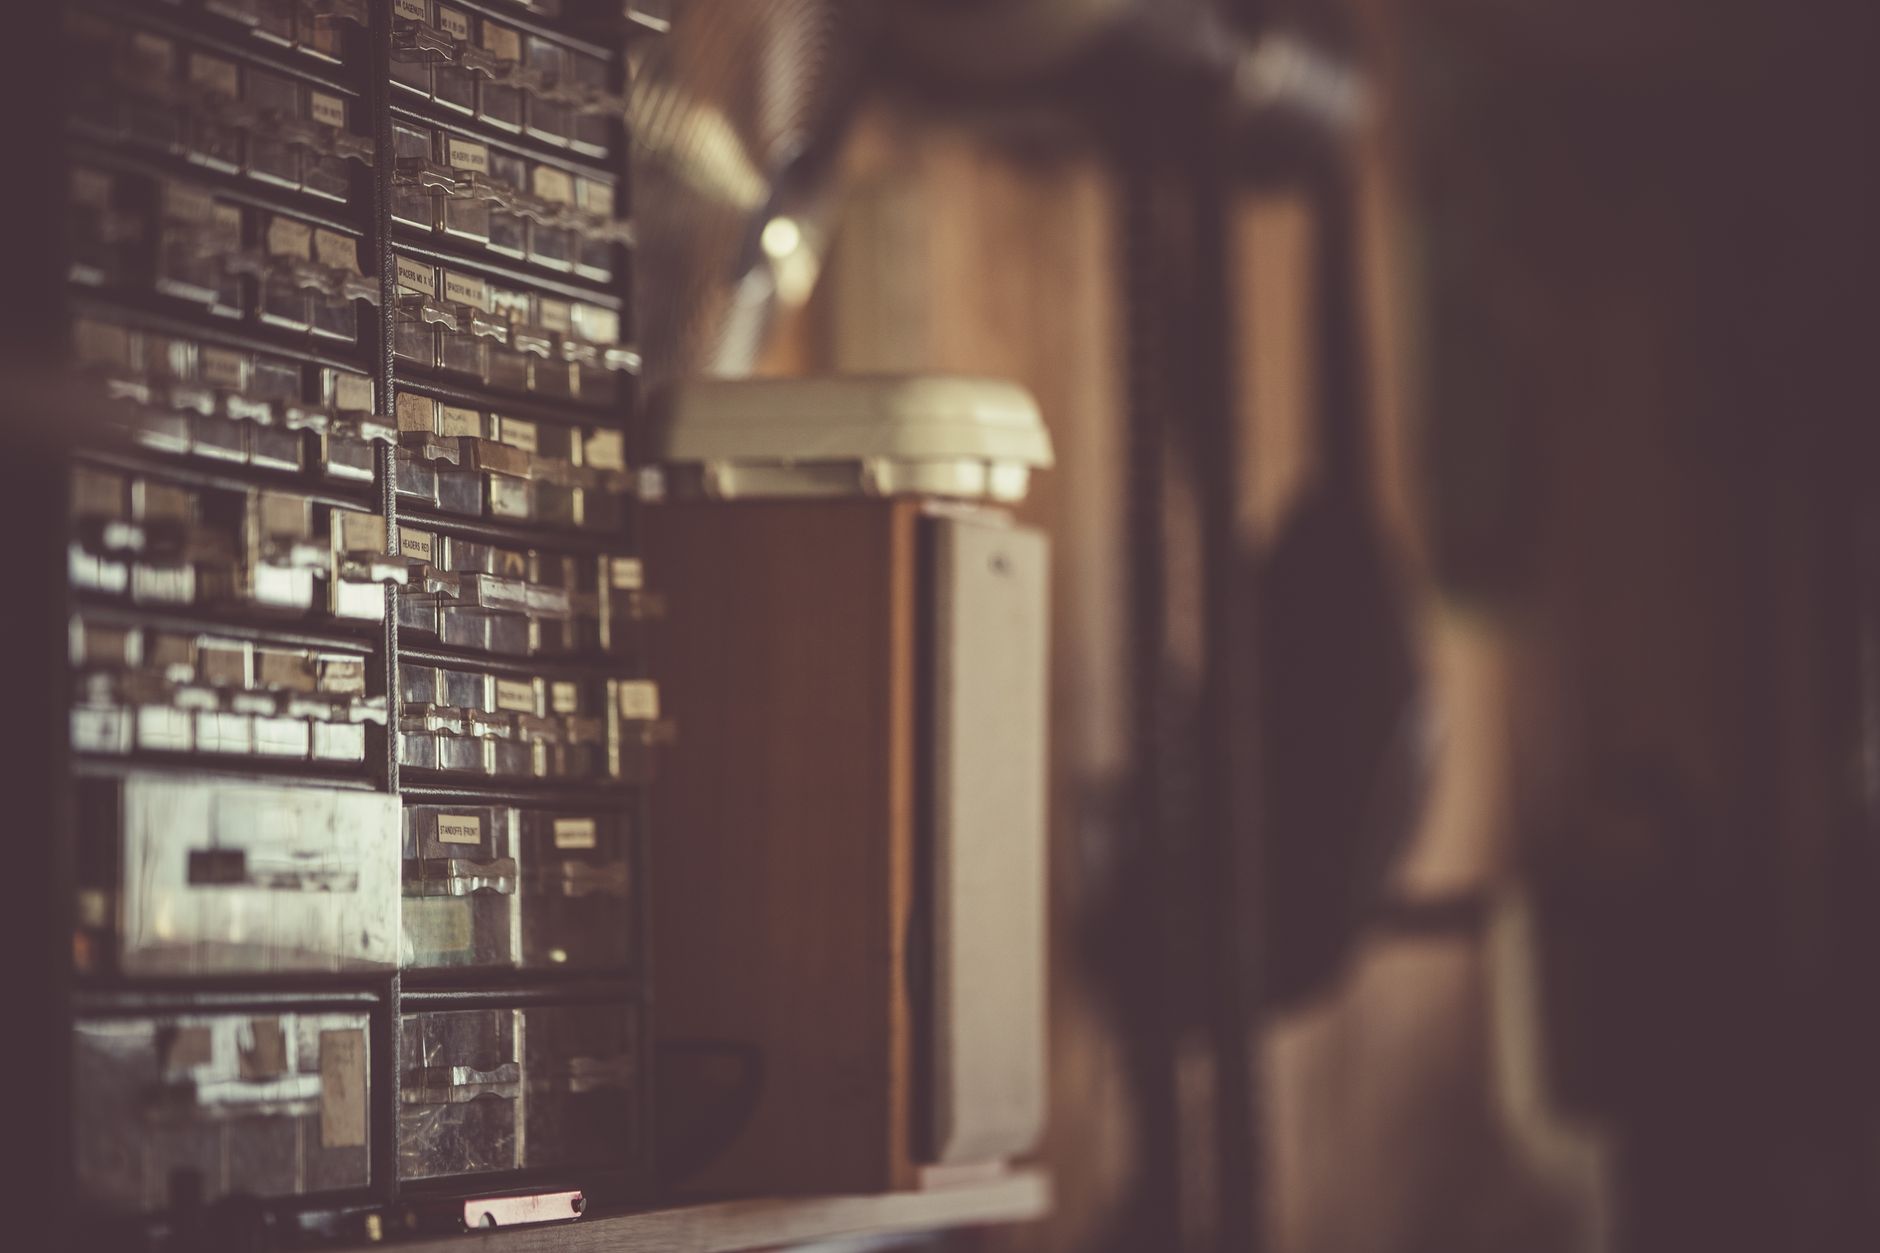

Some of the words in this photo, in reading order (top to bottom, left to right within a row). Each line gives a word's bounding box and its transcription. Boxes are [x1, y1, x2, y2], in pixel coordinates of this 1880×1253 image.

[399, 266, 416, 281] SPACERS
[402, 539, 420, 551] HEADERS
[421, 542, 430, 553] RED
[440, 825, 462, 836] STANDOFFS
